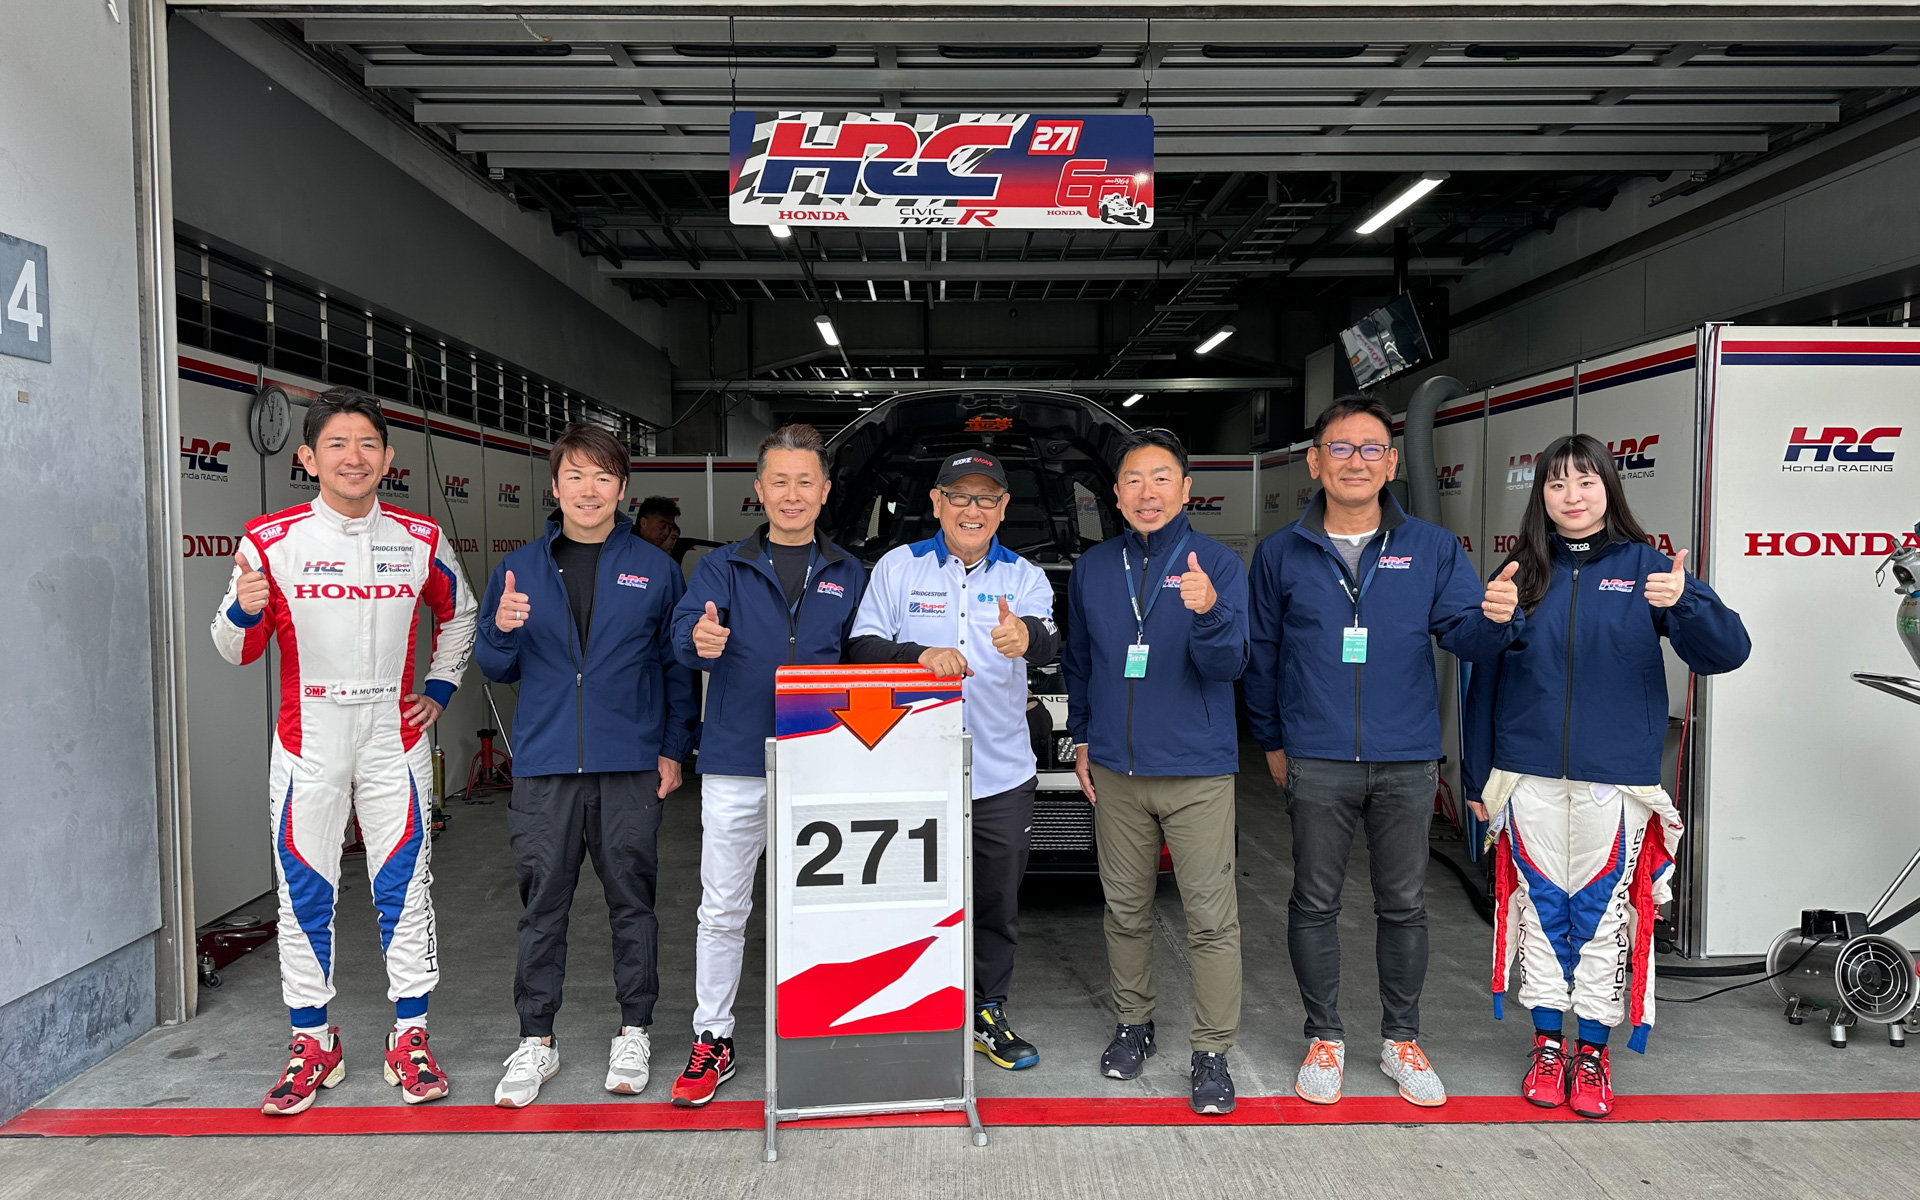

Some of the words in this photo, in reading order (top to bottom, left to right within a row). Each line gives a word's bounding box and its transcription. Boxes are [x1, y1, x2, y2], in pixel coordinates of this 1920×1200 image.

[1030, 125, 1080, 151] 271
[757, 120, 1015, 199] HRC
[778, 211, 850, 221] HONDA
[899, 217, 957, 225] TYPE
[957, 209, 998, 227] R
[0, 260, 43, 342] 4
[1783, 427, 1902, 461] HRC
[1782, 464, 1834, 472] Honda
[1838, 464, 1894, 472] RACING
[201, 473, 229, 482] RACING
[1627, 471, 1655, 479] RACING
[290, 482, 310, 490] Honda
[445, 475, 470, 498] HRC
[499, 483, 521, 504] HRC
[260, 525, 283, 539] OMP
[409, 524, 431, 536] OMP
[183, 534, 242, 557] OND
[303, 561, 346, 573] HRC
[1379, 556, 1413, 567] HRC
[617, 574, 649, 586] HRC
[1599, 579, 1636, 590] HRC
[294, 583, 416, 600] HONDA
[817, 581, 845, 595] HRC
[910, 589, 948, 597] BRIDGESTONE
[987, 593, 1014, 601] STO
[304, 687, 326, 696] OMP
[796, 818, 938, 887] 271
